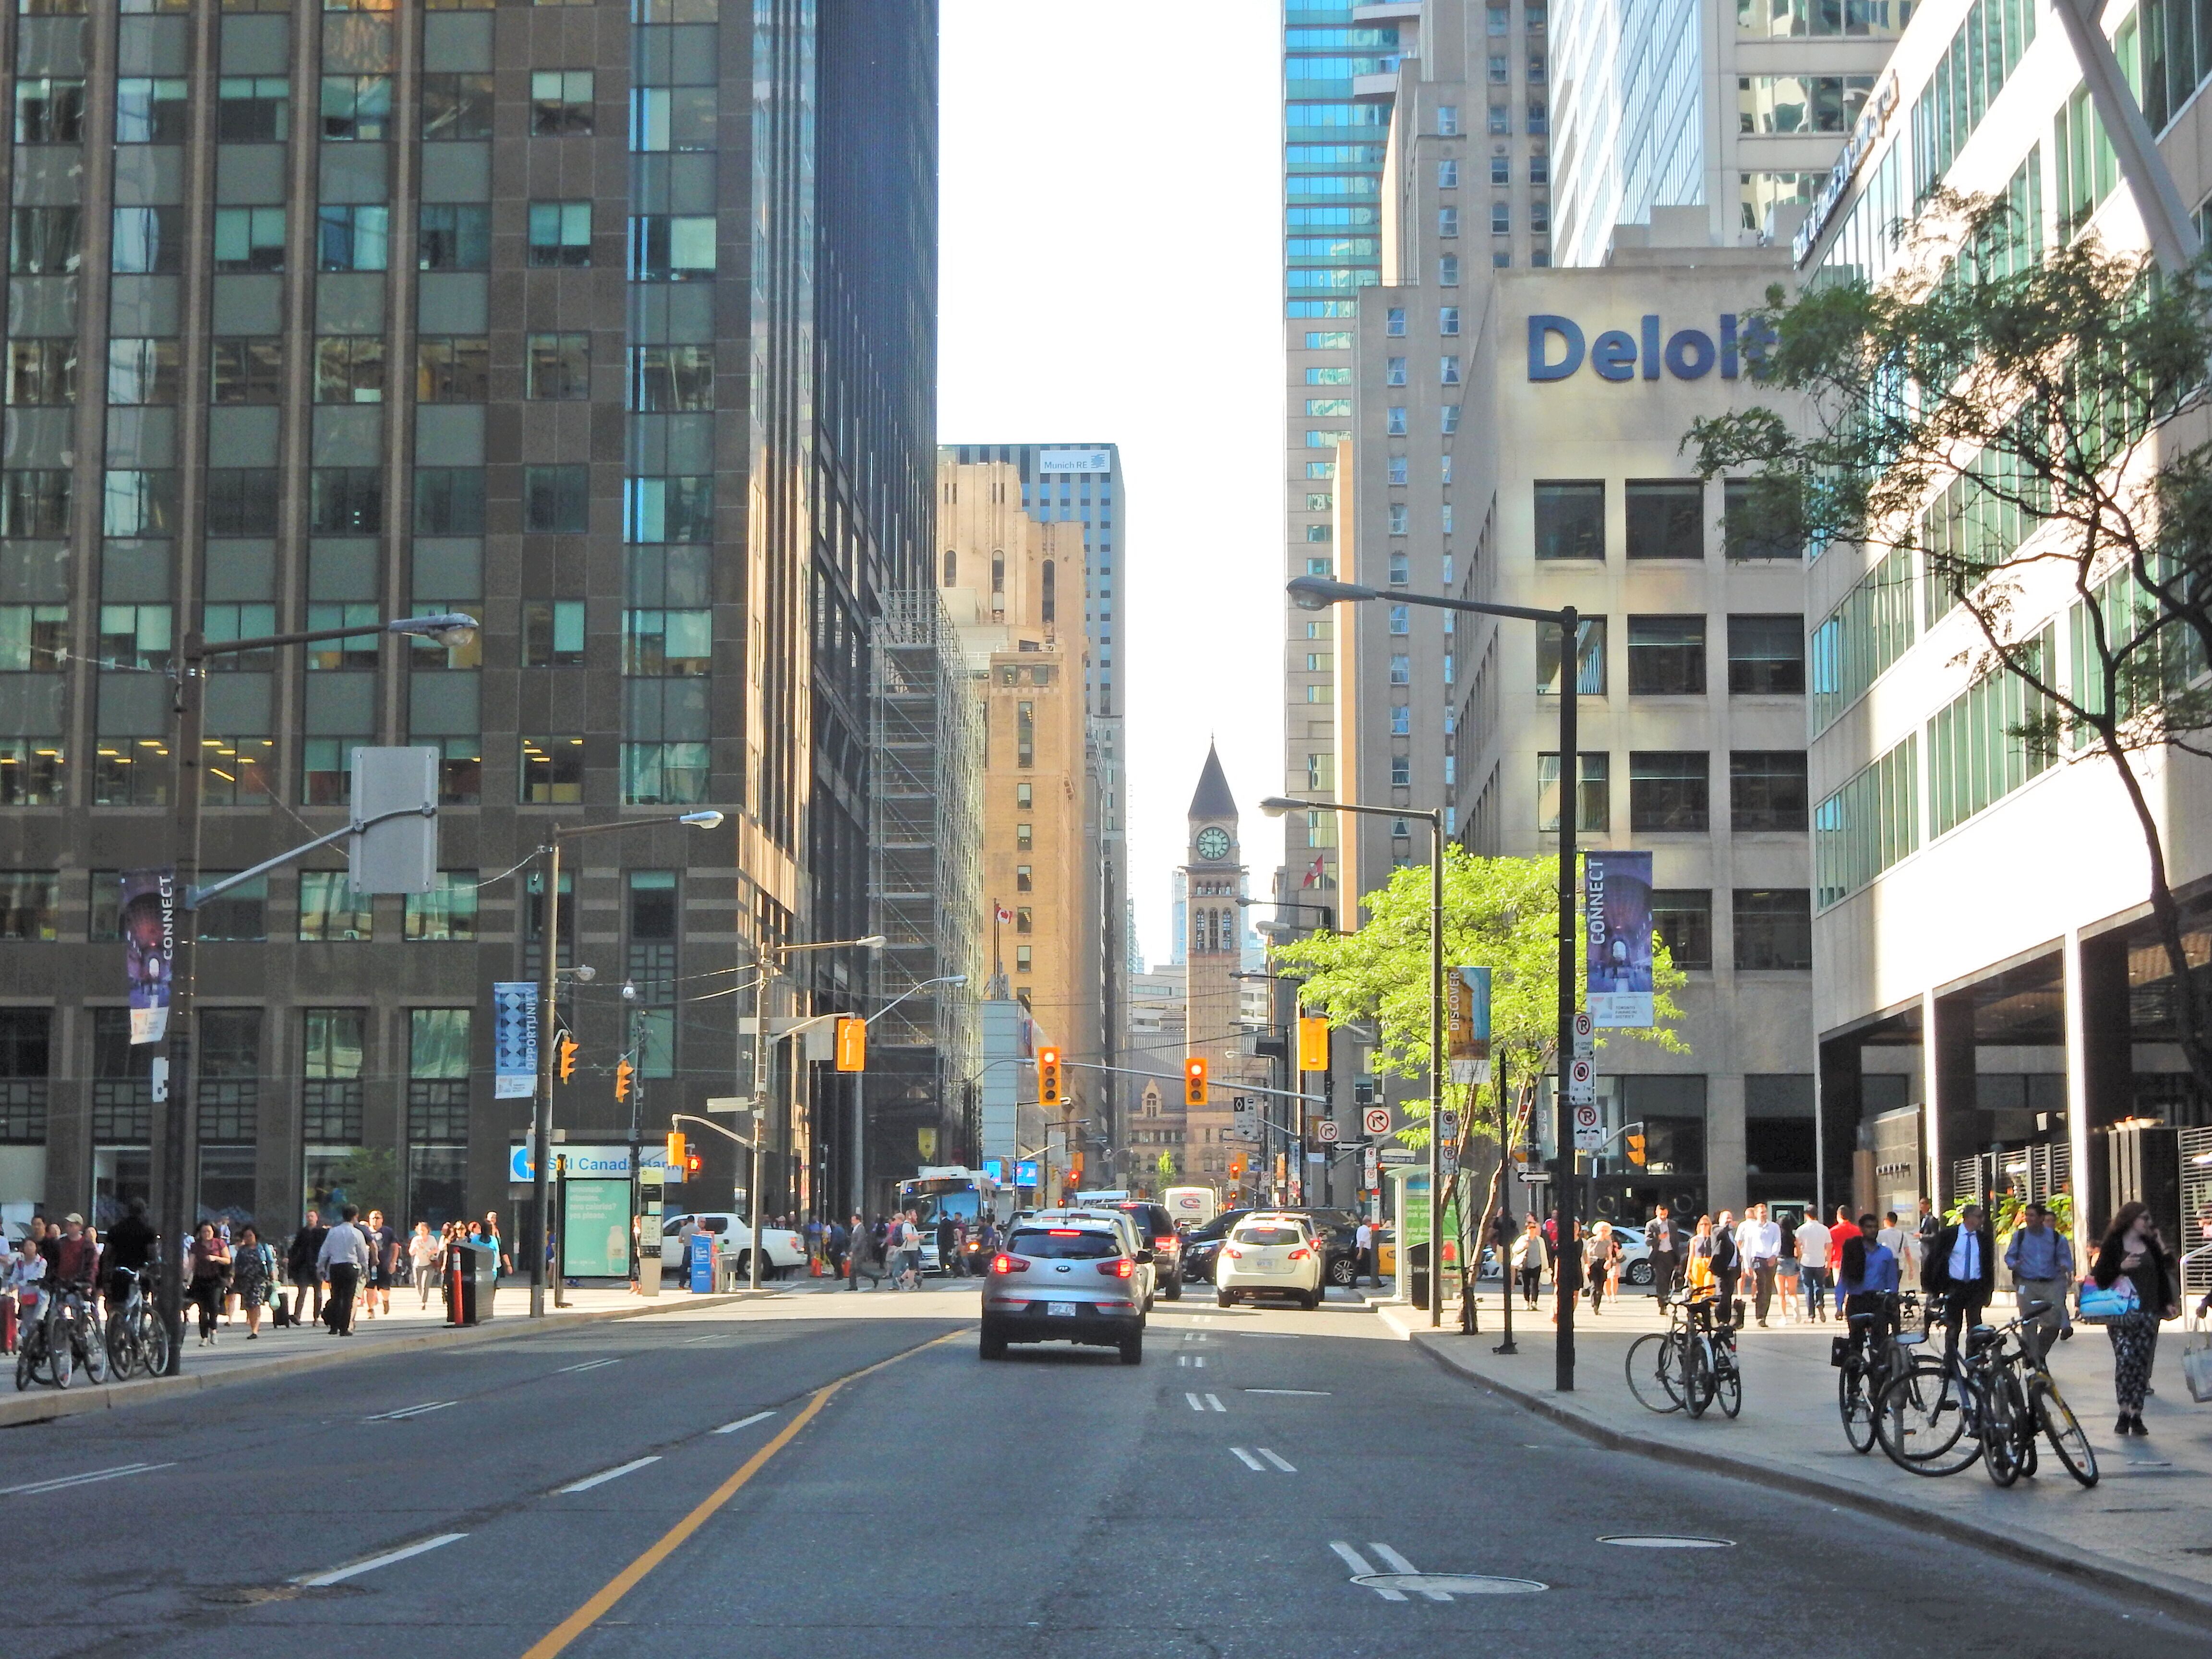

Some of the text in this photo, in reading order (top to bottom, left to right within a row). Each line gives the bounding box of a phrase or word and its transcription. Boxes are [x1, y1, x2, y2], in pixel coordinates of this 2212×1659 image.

[1528, 314, 1783, 381] Deloit
[1044, 461, 1075, 469] Munich
[159, 875, 173, 960] CONNECT
[1588, 858, 1605, 945] CONNECT
[526, 988, 536, 1070] OPPORTUNITY
[1450, 972, 1459, 1031] DISCOVER
[579, 1157, 632, 1170] Canad
